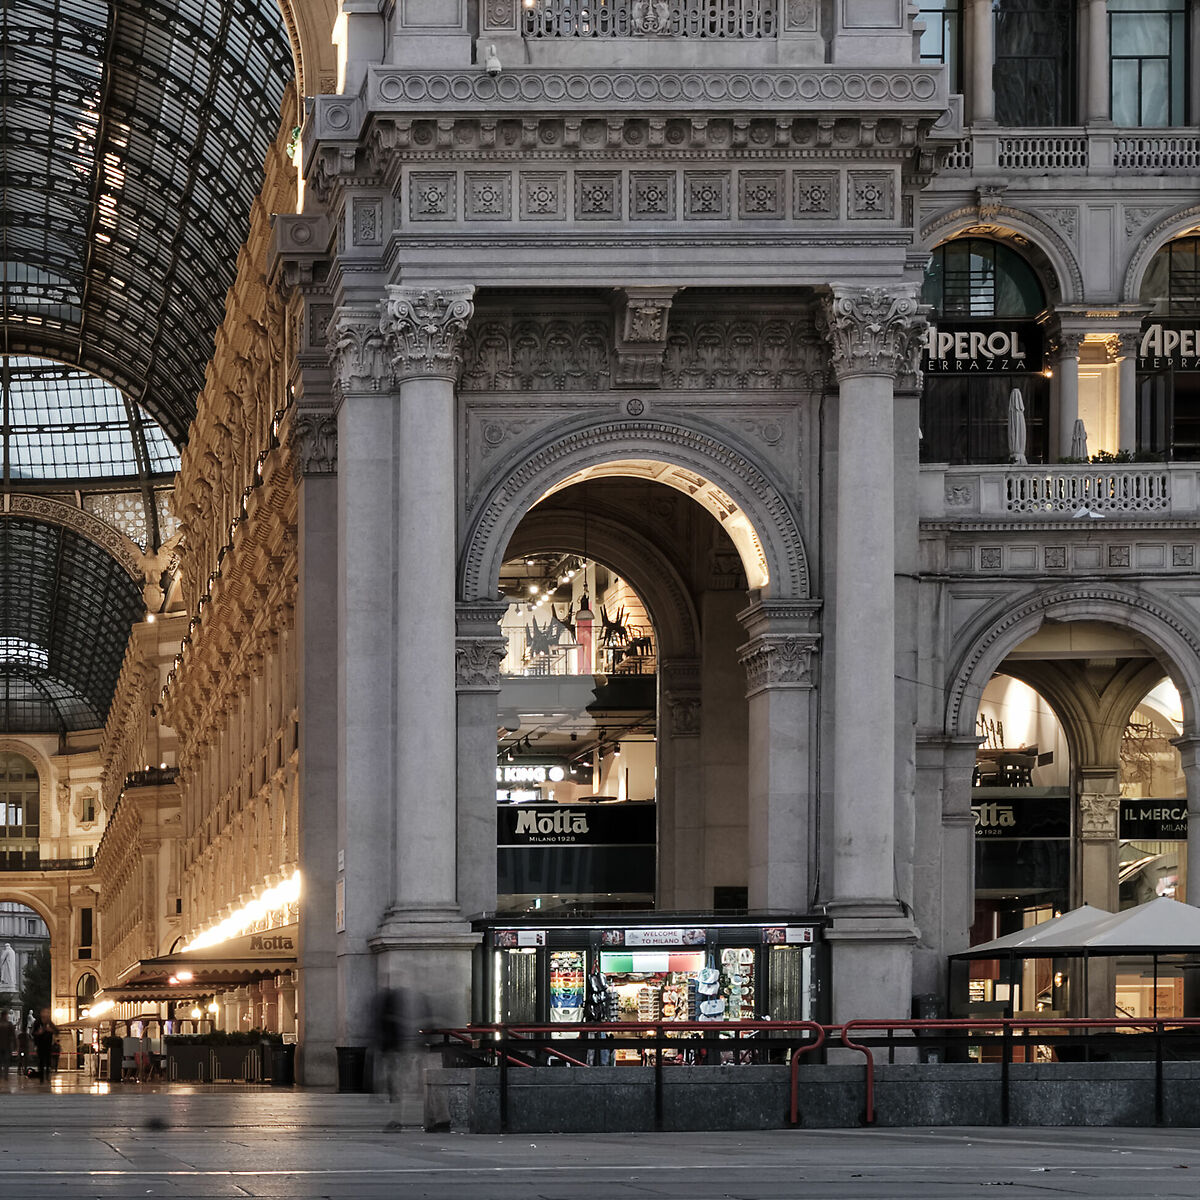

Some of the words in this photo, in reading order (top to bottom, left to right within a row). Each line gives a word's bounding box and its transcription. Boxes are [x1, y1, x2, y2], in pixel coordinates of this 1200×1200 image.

[1140, 324, 1200, 357] APE
[505, 767, 546, 782] KING
[515, 809, 589, 834] Motta
[1125, 809, 1137, 821] IL
[250, 935, 294, 950] Motta
